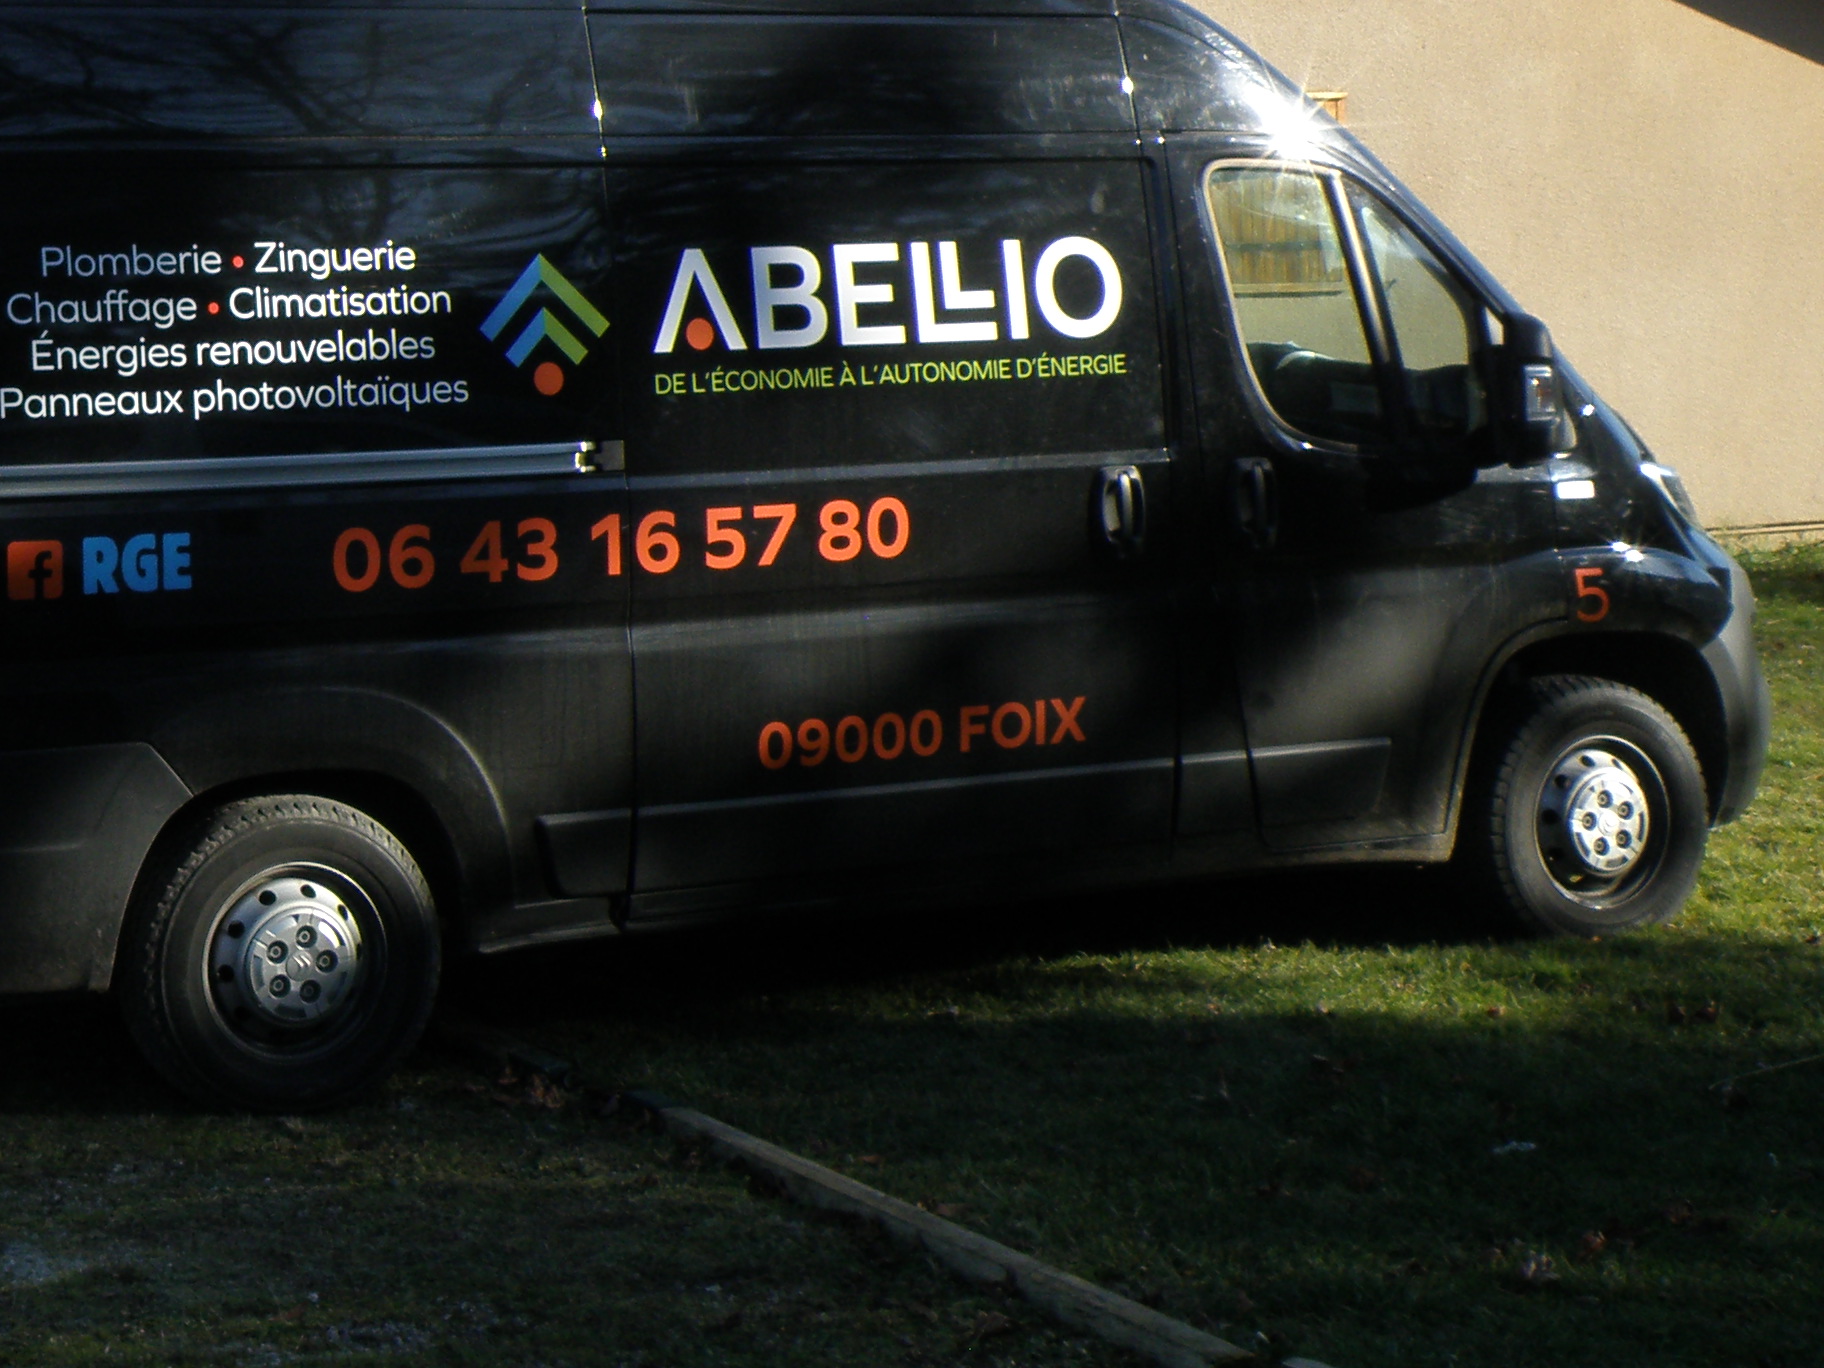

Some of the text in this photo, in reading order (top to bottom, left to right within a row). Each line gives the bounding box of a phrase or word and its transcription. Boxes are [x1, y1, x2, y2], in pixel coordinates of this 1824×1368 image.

[41, 240, 417, 280] Plomberie Zinguerie
[7, 285, 452, 329] Chauffage Climatisation
[653, 236, 1123, 353] ABELLIO
[31, 329, 435, 377] Énergies renouvelables
[655, 352, 1127, 395] DE L'ÉCONOMIE À L'AUTONOMIE D'ÉNERGIE
[0, 375, 469, 420] Panneaux photovoltaïques
[82, 532, 193, 595] RGE
[332, 496, 910, 592] 06 43 16 57 80
[1575, 567, 1610, 623] 5
[758, 695, 1087, 770] 09000 FOIX
